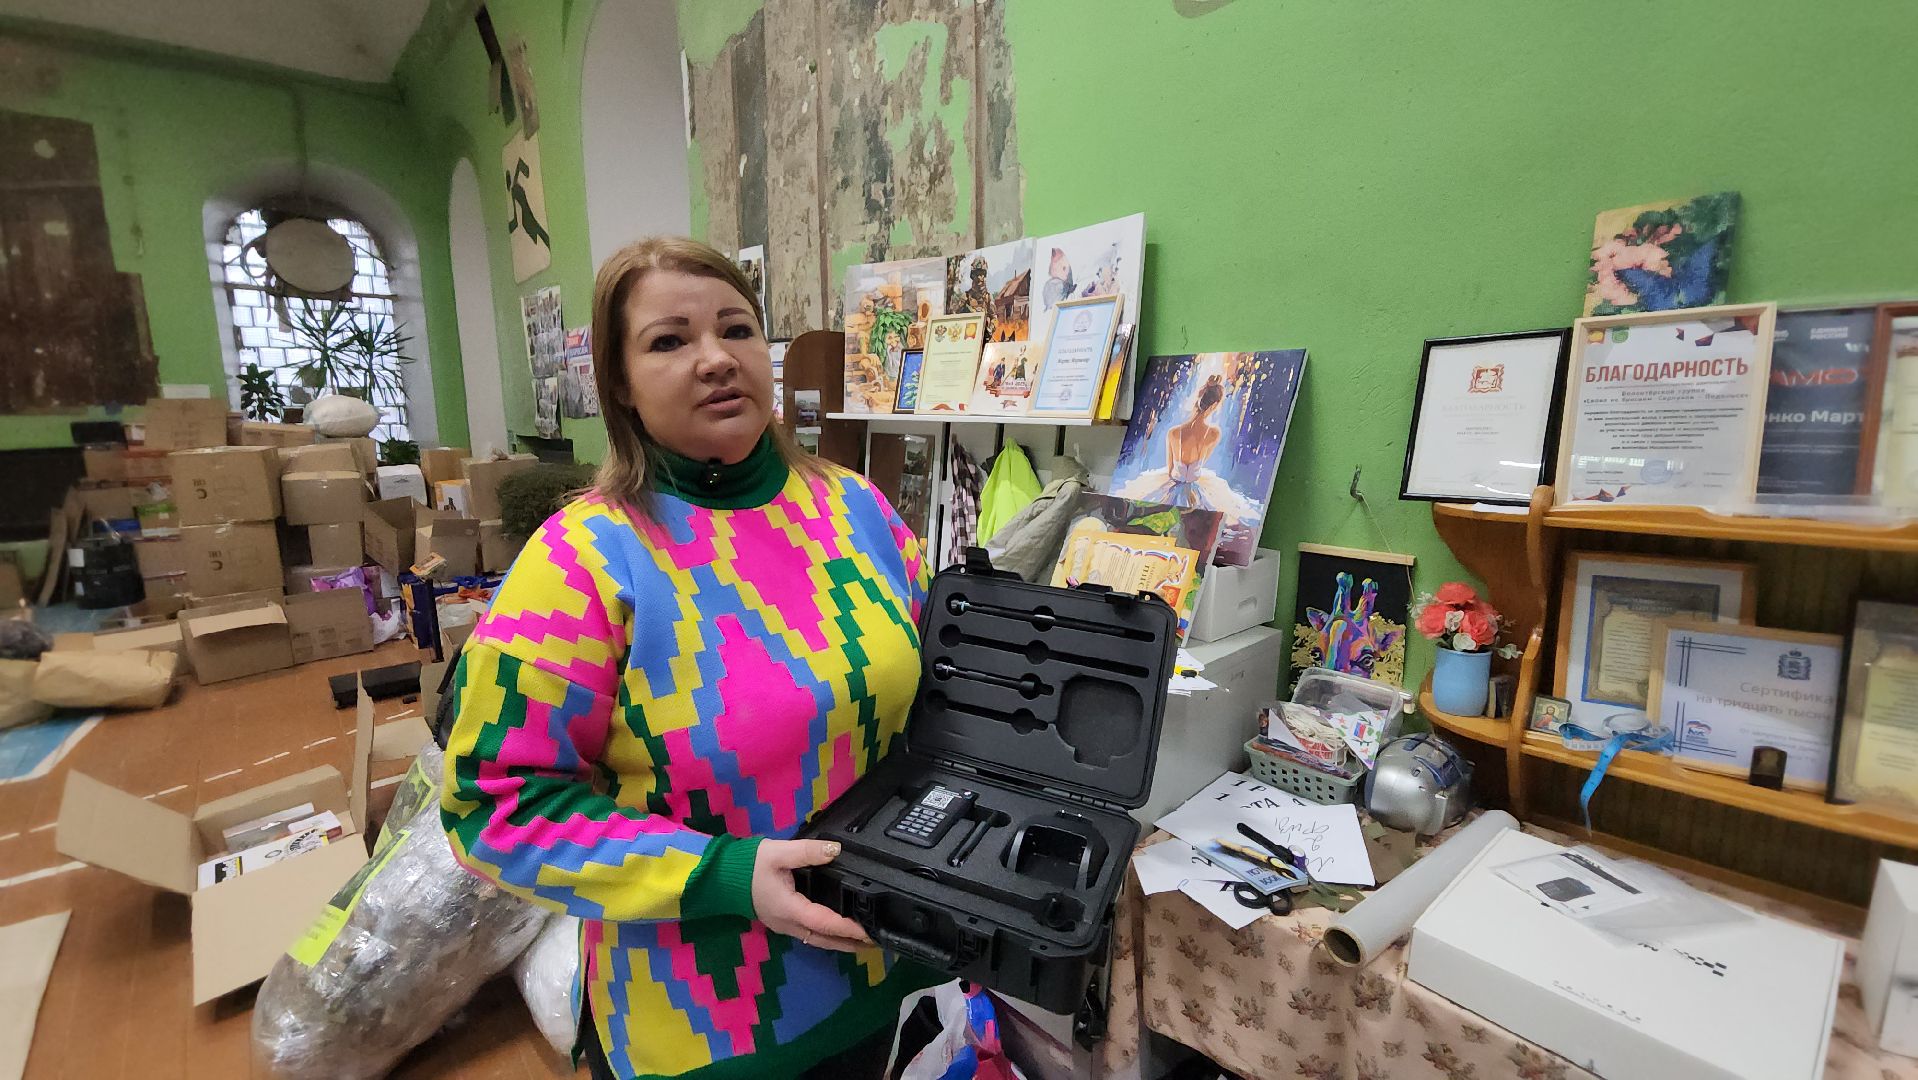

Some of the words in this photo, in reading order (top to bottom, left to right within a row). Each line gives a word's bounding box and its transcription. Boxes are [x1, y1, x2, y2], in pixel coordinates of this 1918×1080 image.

[1585, 357, 1749, 383] БЛАГОДАРНОСТЬ
[1696, 696, 1713, 704] на
[1717, 697, 1783, 714] тридцать
